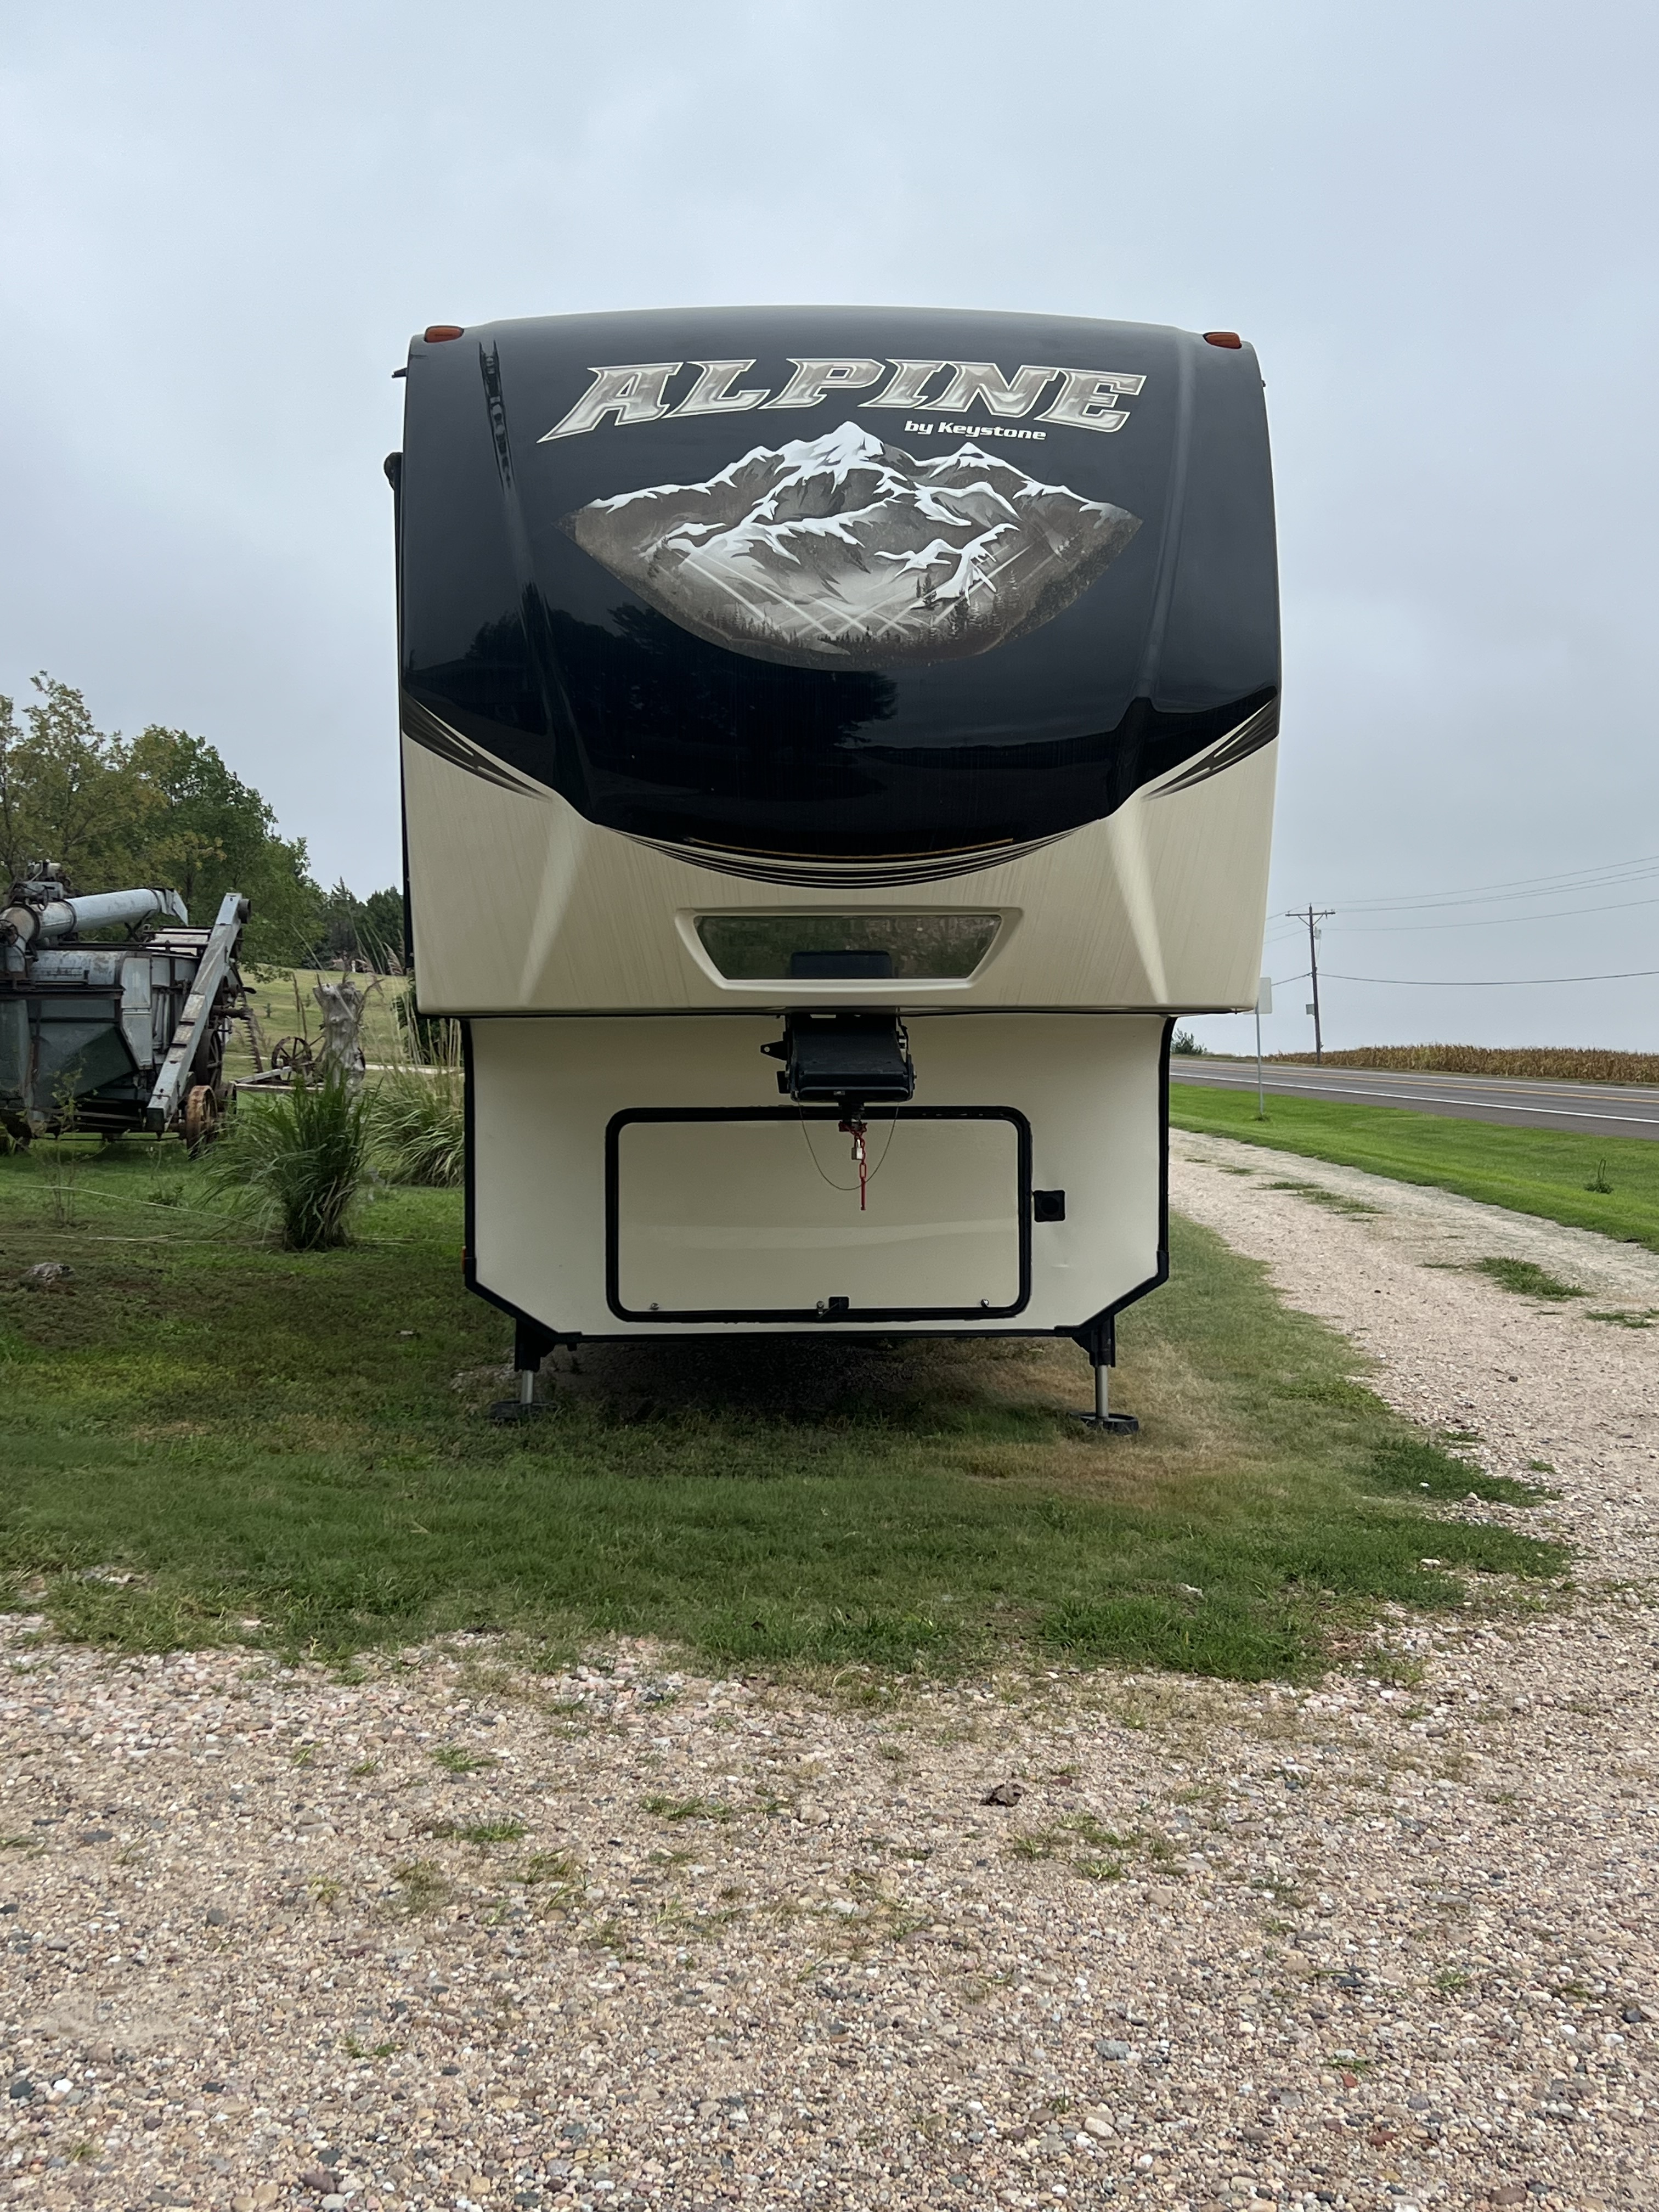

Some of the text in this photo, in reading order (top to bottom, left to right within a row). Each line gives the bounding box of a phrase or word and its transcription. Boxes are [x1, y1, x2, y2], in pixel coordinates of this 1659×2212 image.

[537, 358, 1147, 443] ALPINE
[904, 420, 1047, 440] by Keystone
